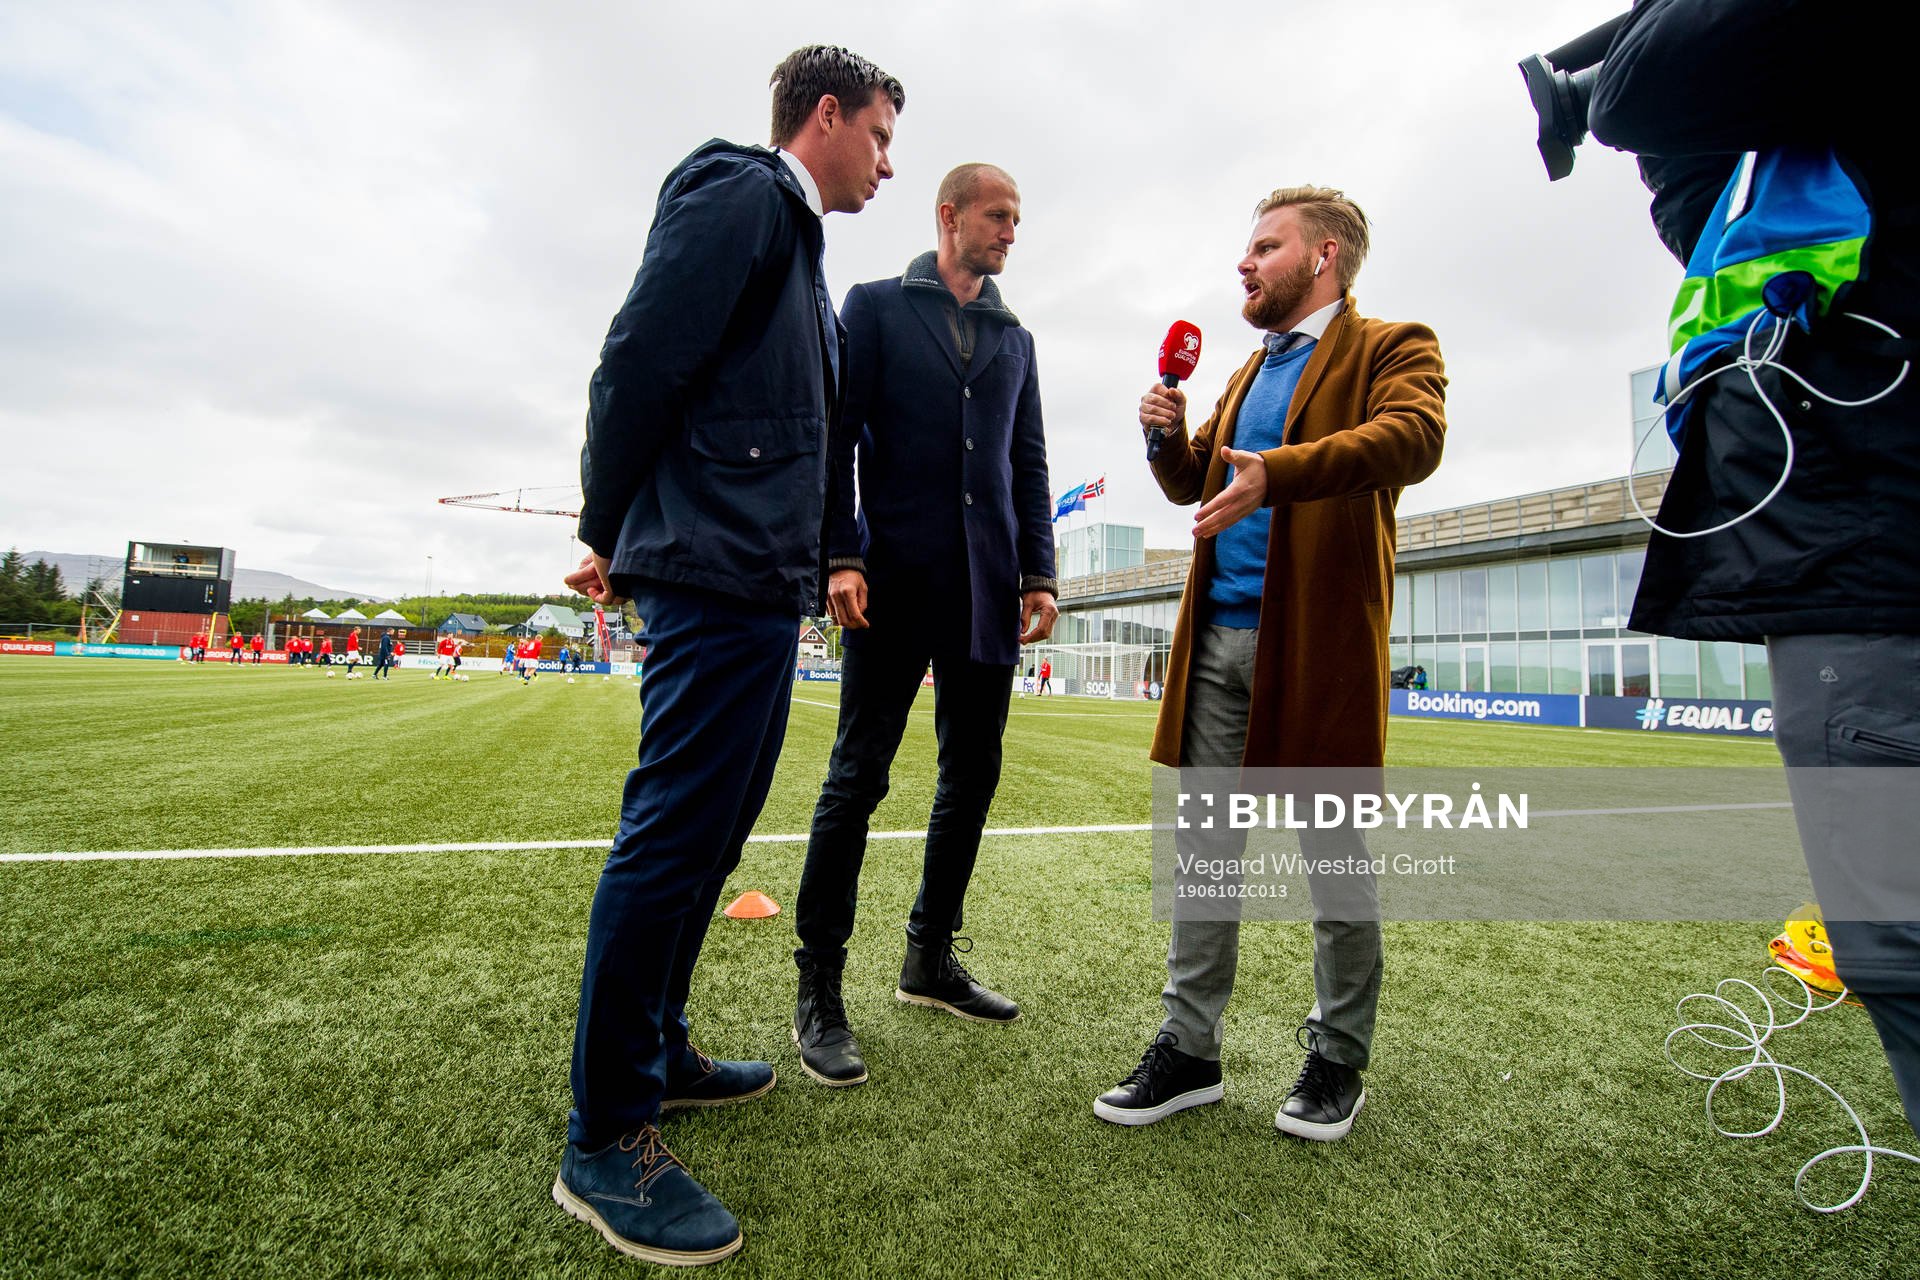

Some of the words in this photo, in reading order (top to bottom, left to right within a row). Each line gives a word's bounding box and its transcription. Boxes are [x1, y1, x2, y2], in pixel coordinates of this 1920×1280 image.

[2, 642, 53, 652] QUALIFIERS
[115, 647, 140, 655] EURO
[142, 648, 166, 656] 2020
[810, 671, 841, 680] Booking
[1407, 692, 1540, 719] Booking.com
[1751, 707, 1774, 732] G
